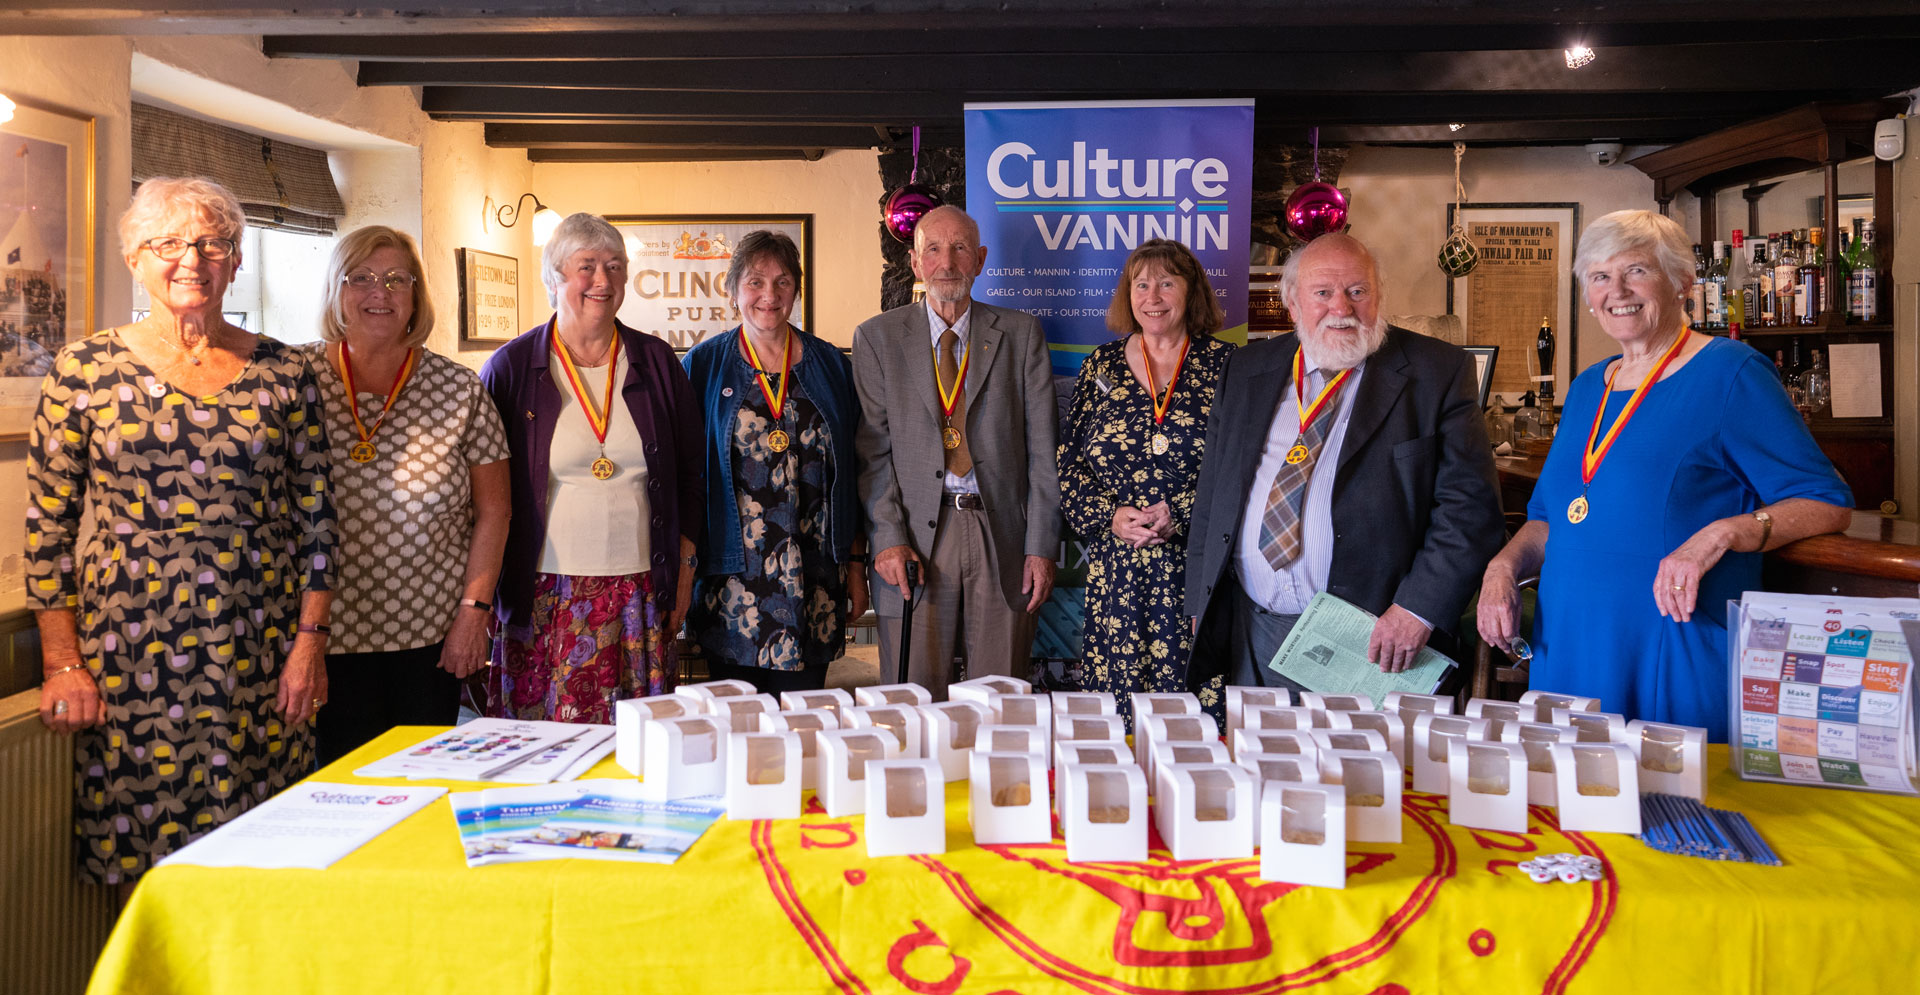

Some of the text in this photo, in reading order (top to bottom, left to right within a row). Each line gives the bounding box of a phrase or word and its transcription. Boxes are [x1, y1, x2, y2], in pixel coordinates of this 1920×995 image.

[987, 141, 1229, 199] Culture
[1474, 226, 1488, 236] ISLE
[1489, 226, 1498, 236] OF
[1499, 226, 1515, 236] MAN
[1515, 226, 1544, 237] RAILWAY
[1515, 248, 1534, 260] FAIR
[1537, 248, 1553, 260] DAY
[986, 268, 1228, 277] CULTURE MANNIN IDENTITY AULL
[986, 288, 1015, 297] GAELG
[1022, 288, 1042, 297] OUR
[1044, 288, 1076, 297] ISLAND
[1084, 288, 1104, 297] FILM
[1059, 308, 1079, 317] OUR
[1824, 622, 1841, 631] 40
[1793, 632, 1824, 642] Learn
[1833, 638, 1865, 646] Listen
[1798, 658, 1820, 667] Snap
[1867, 663, 1899, 676] Sing
[1752, 684, 1769, 695] Say
[1786, 689, 1811, 698] Make
[1821, 693, 1857, 703] Discover
[1867, 698, 1893, 708] Enjoy
[1826, 727, 1844, 736] Pay
[1860, 733, 1881, 741] Have
[1820, 761, 1850, 771] Watch
